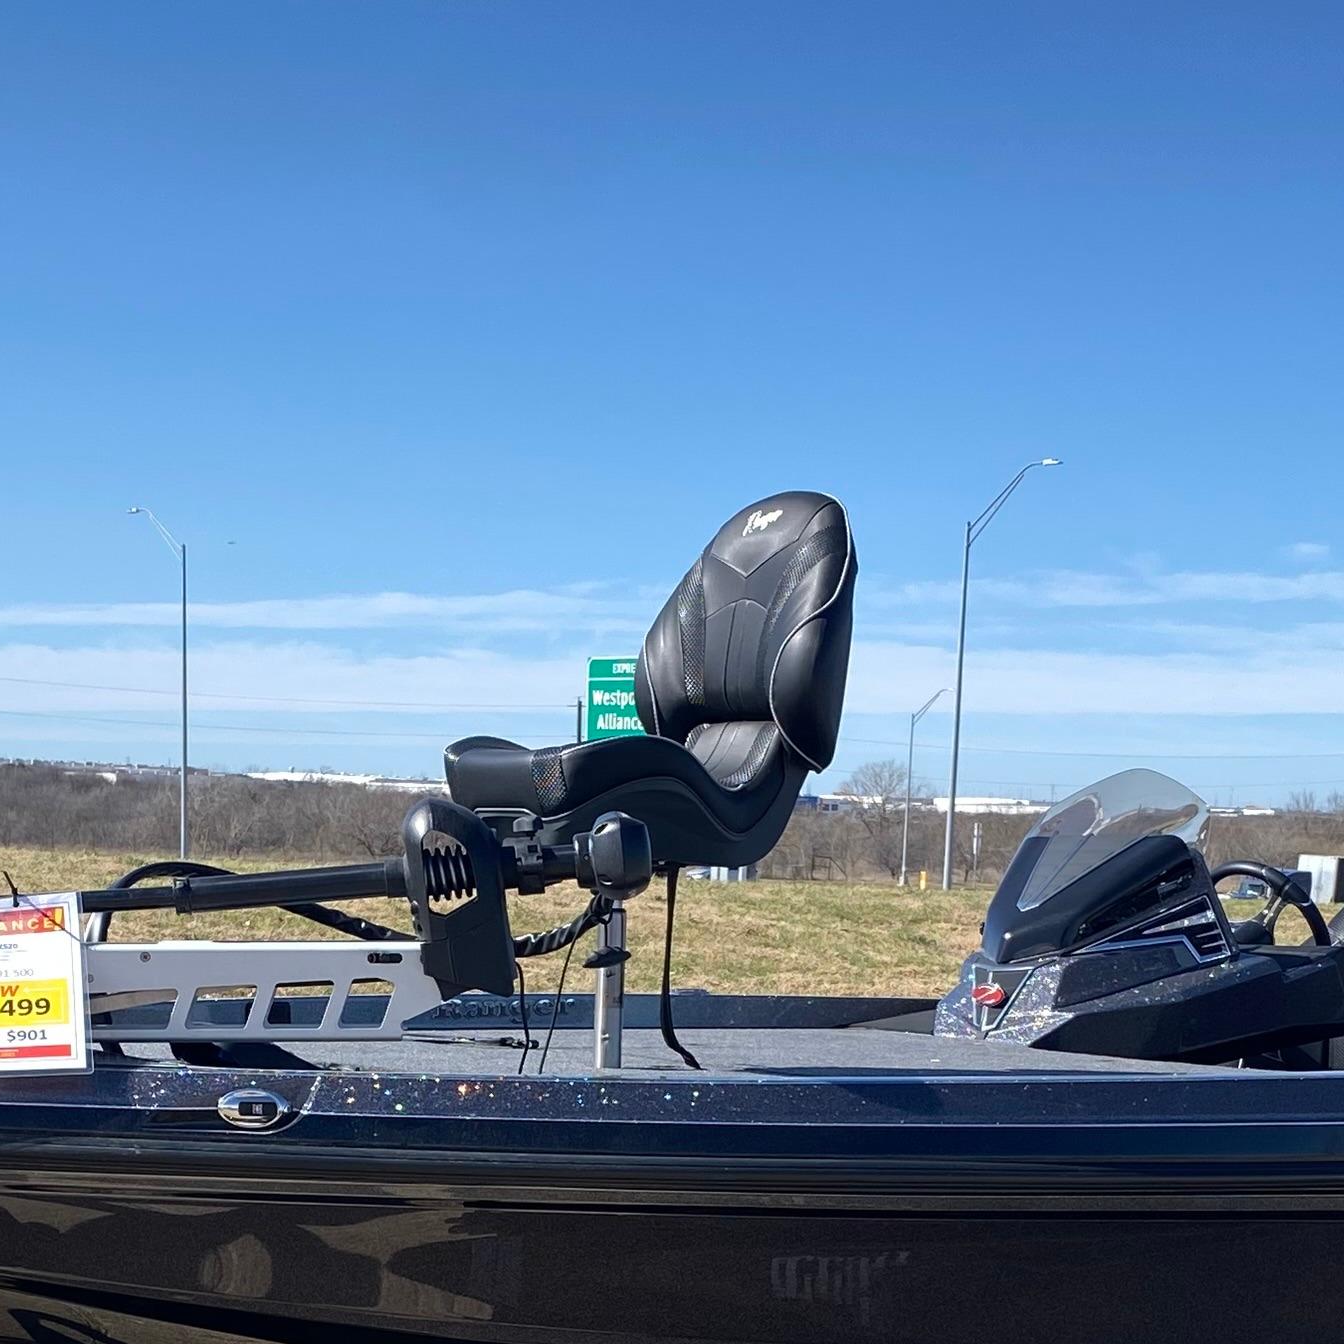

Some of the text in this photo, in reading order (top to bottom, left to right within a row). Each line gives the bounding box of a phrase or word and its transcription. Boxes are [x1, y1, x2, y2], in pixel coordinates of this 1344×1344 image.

[612, 663, 636, 674] EXPRE
[592, 689, 636, 709] Westpo
[6, 1029, 49, 1043] $901
